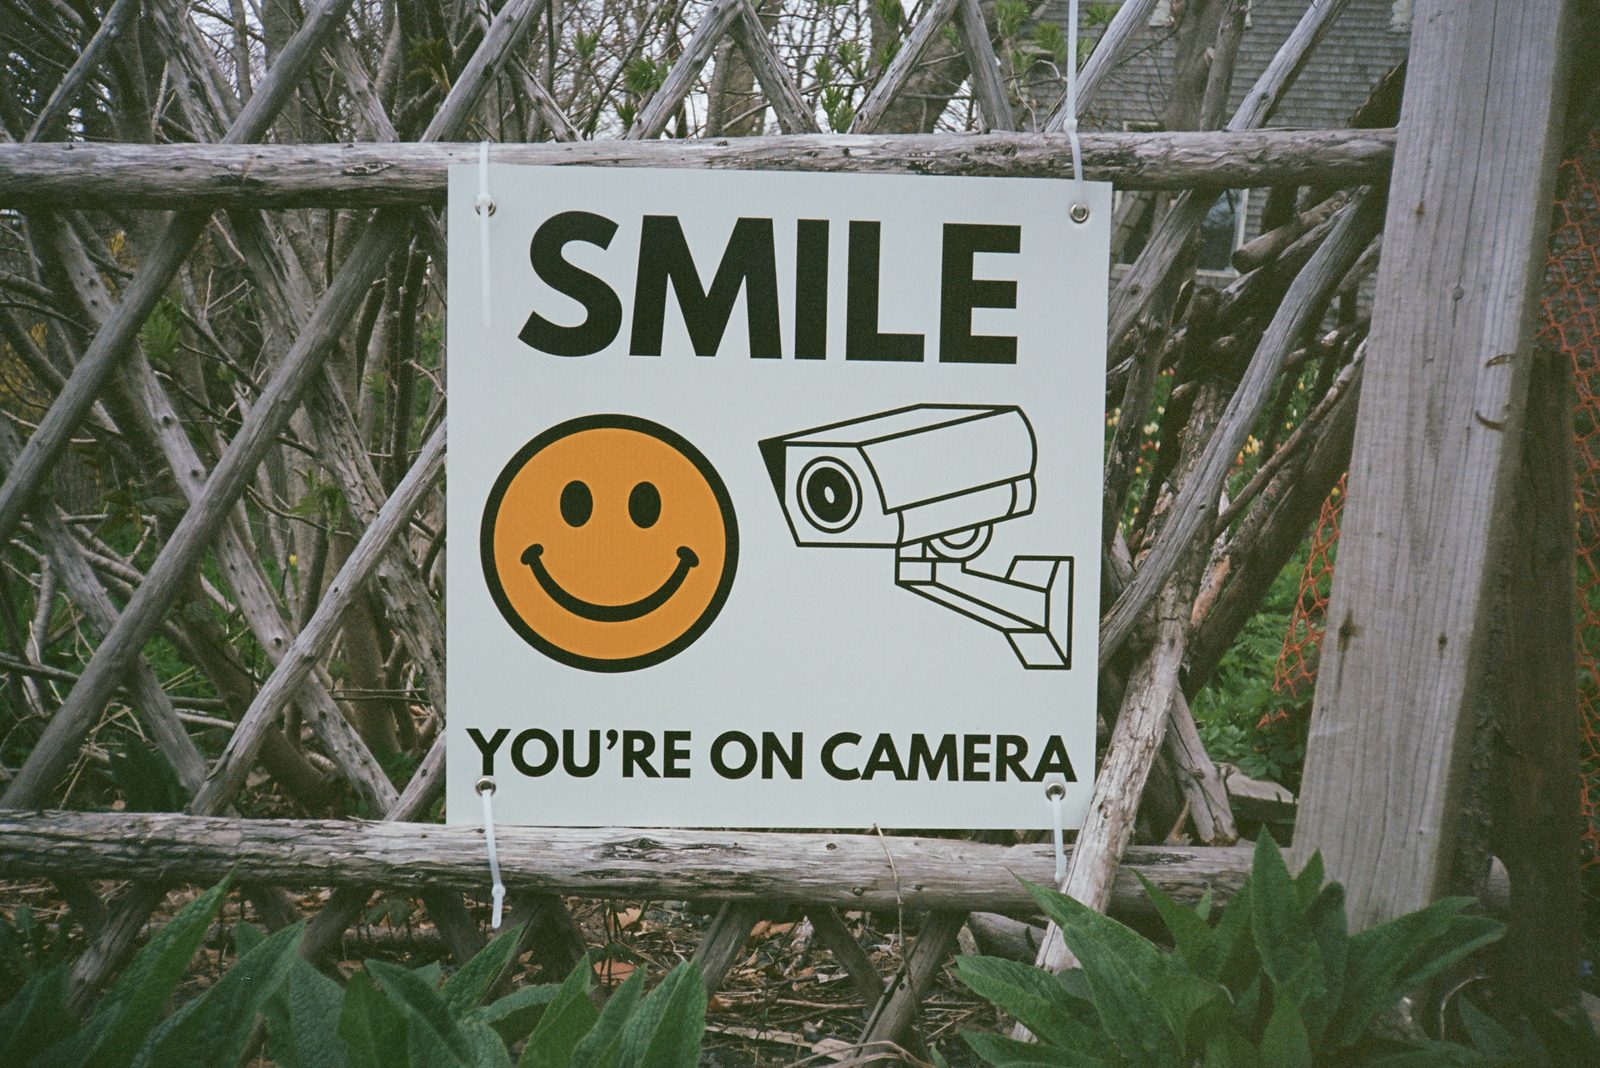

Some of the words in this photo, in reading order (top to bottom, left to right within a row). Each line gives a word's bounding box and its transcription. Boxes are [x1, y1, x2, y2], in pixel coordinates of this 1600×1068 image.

[517, 210, 1022, 365] SMILE
[466, 728, 692, 779] YOU’RE
[710, 730, 803, 780] ON
[820, 731, 1078, 783] CAMERA
